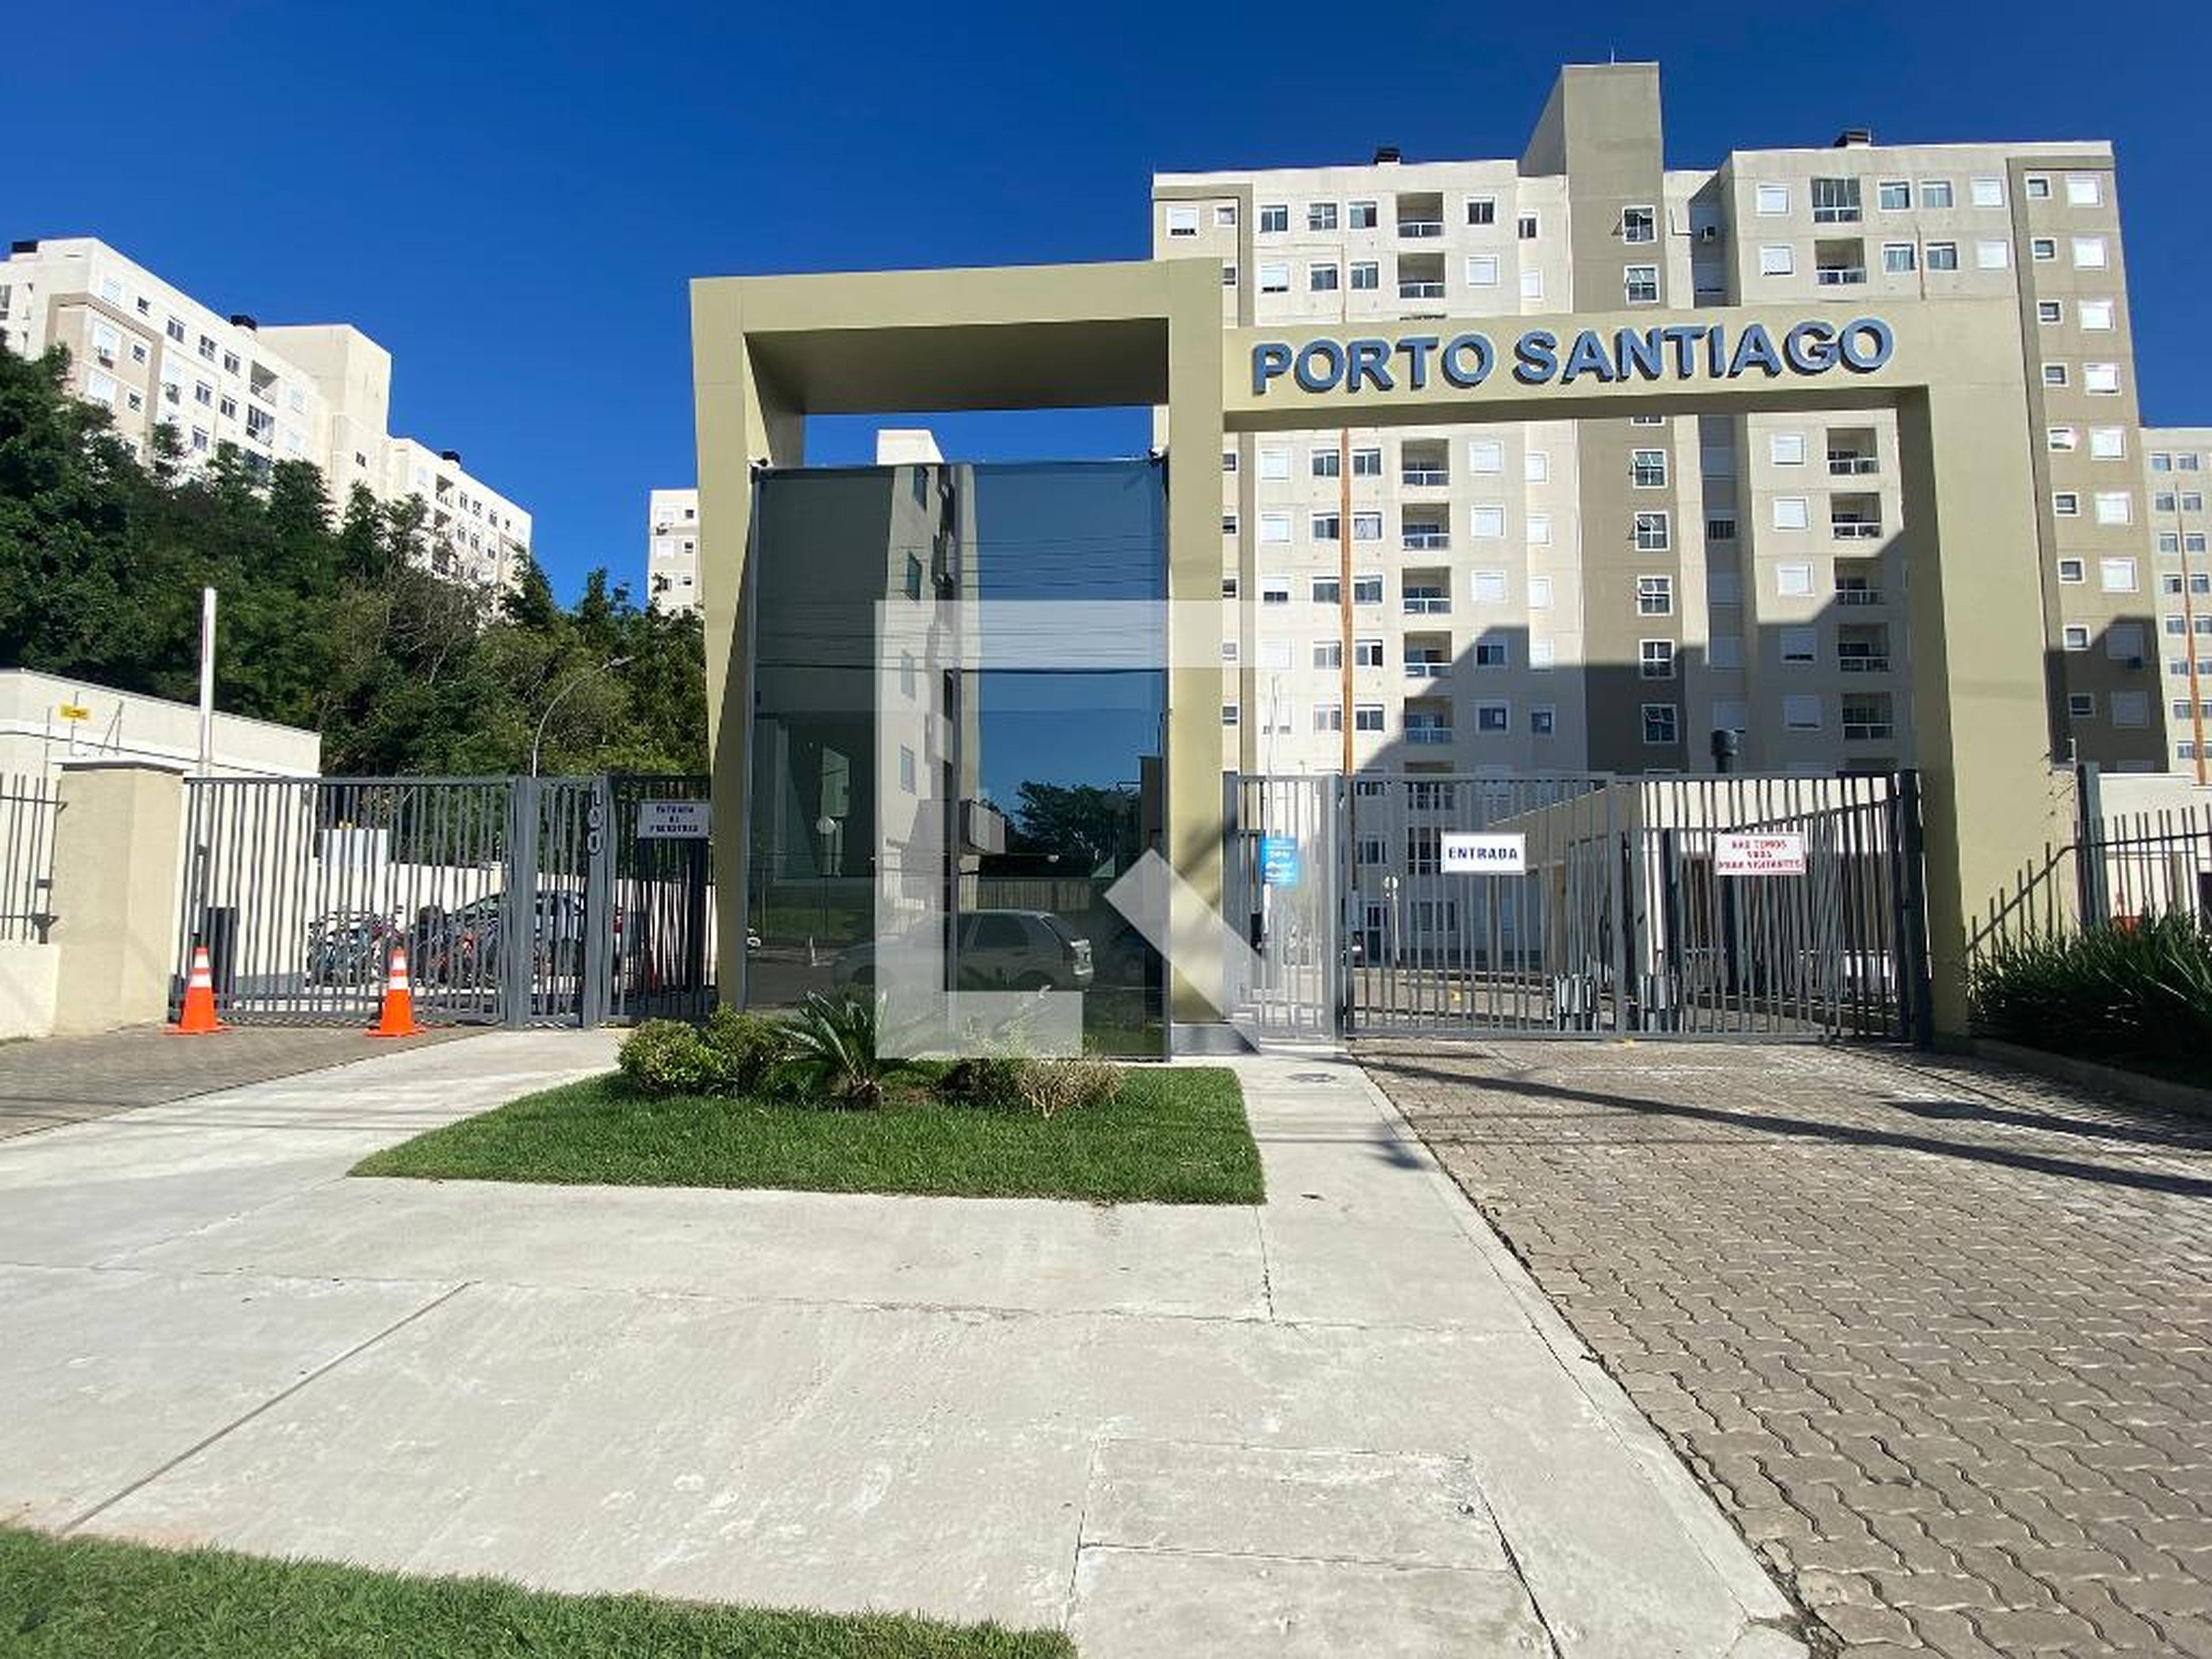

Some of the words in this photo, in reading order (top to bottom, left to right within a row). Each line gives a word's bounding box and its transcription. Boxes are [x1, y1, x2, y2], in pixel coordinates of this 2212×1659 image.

[1252, 334, 1494, 395] PORTO
[1512, 317, 1894, 385] SANTIAGO
[1448, 847, 1518, 859] ENTRADA
